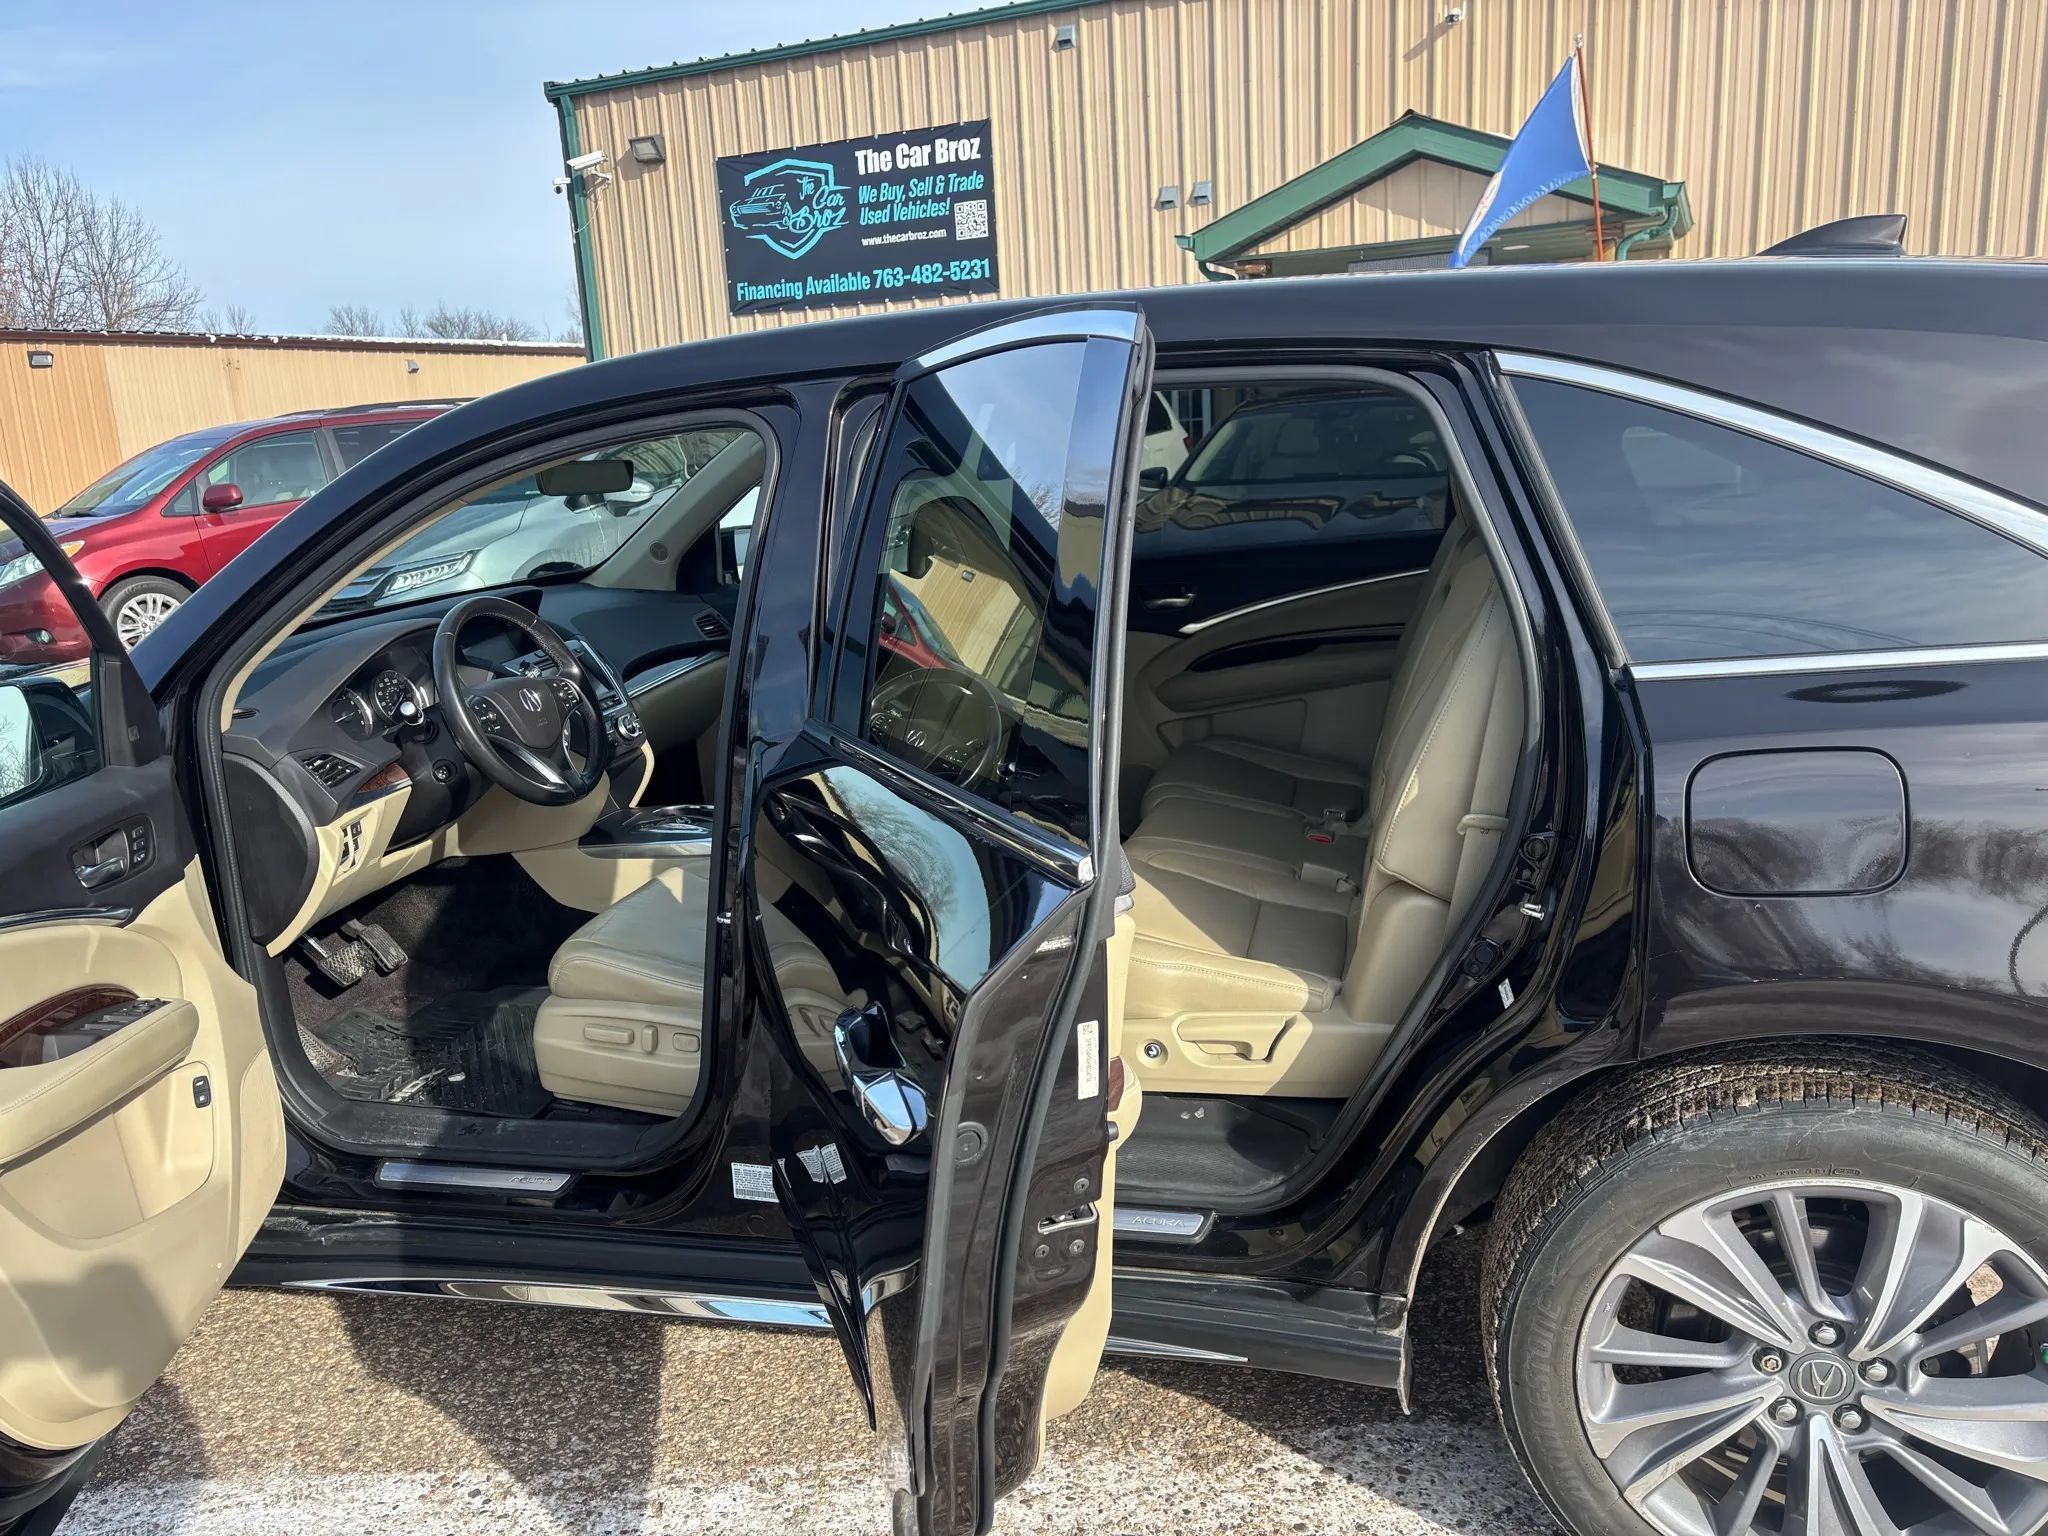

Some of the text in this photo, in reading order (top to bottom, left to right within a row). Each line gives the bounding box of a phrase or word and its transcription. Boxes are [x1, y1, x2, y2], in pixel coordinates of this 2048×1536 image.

[855, 137, 981, 175] The Car Broz
[812, 185, 846, 209] Car
[858, 170, 985, 205] We Buy, Sell & Trade
[789, 207, 850, 234] Broz
[859, 197, 951, 226] Used Vehicles!
[861, 228, 947, 247] www.thecarbroz.com
[736, 257, 991, 302] Financing Available 763-482-5231
